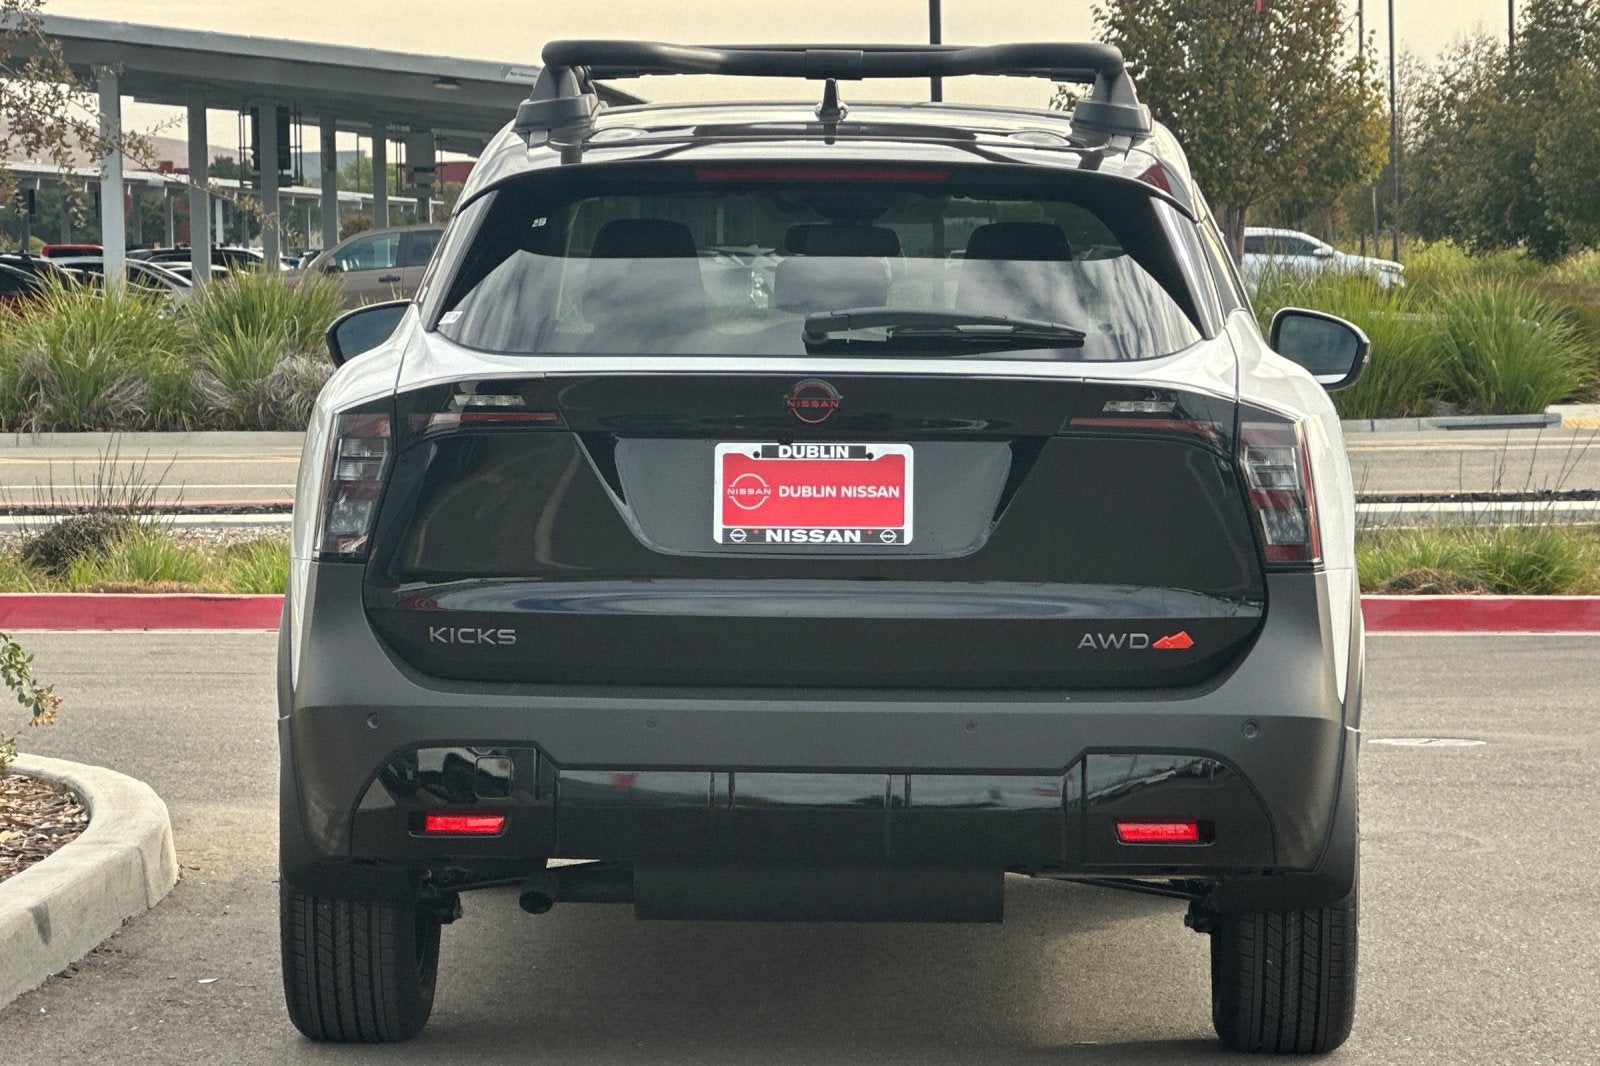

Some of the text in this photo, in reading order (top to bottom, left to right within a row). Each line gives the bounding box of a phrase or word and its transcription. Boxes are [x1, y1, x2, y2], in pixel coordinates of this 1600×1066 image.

[786, 400, 839, 408] NISSAN
[778, 445, 849, 459] DUBLIN
[727, 487, 771, 495] NISSAN
[779, 486, 900, 498] DUBLIN NISSAN
[765, 529, 861, 543] NISSAN
[429, 626, 517, 645] KICKS
[1077, 633, 1150, 649] AWD
